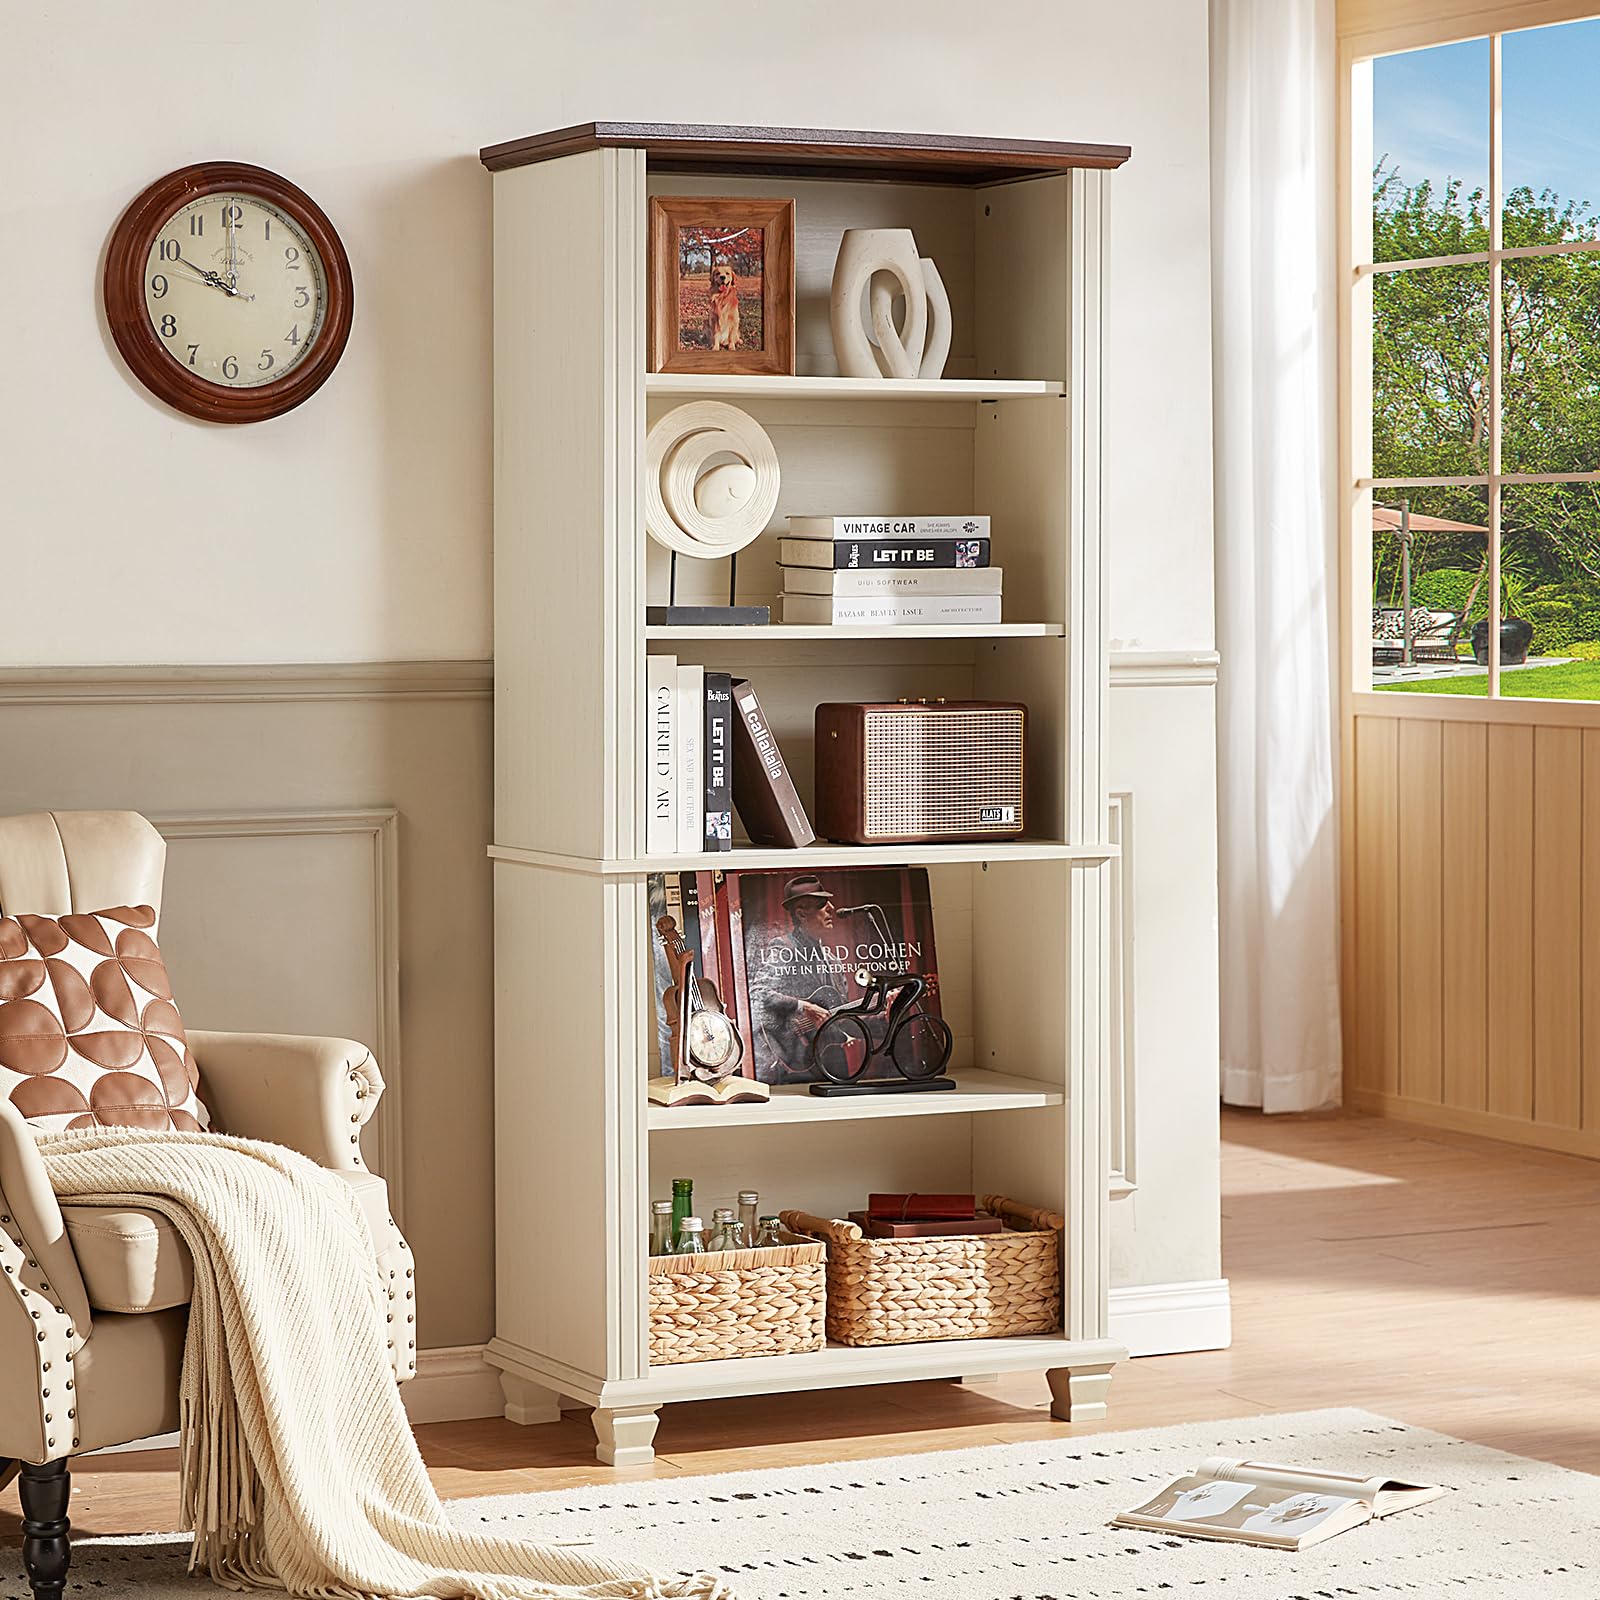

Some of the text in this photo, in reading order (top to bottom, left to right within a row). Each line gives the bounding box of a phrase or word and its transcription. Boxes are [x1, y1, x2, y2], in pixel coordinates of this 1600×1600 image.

[190, 214, 203, 236] 11
[221, 205, 243, 229] 12
[265, 219, 270, 240] 1
[160, 239, 181, 262] 10
[285, 247, 300, 270] 2
[151, 275, 169, 299] 9
[293, 286, 310, 308] 3
[160, 314, 177, 338] 8
[284, 324, 301, 346] 4
[187, 344, 200, 365] 7
[257, 349, 275, 371] 5
[222, 356, 239, 379] 6
[843, 522, 916, 534] VINTAGE CAR
[873, 549, 935, 562] LET IT BE
[838, 609, 866, 618] BAZAAR
[657, 686, 671, 757] GALERIE
[712, 718, 724, 788] LET IT BE
[657, 786, 670, 823] ART
[760, 942, 922, 965] LEONARD COHEN
[774, 965, 798, 976] LIVE
[800, 964, 813, 975] IN
[816, 961, 887, 974] FREDERICTON
